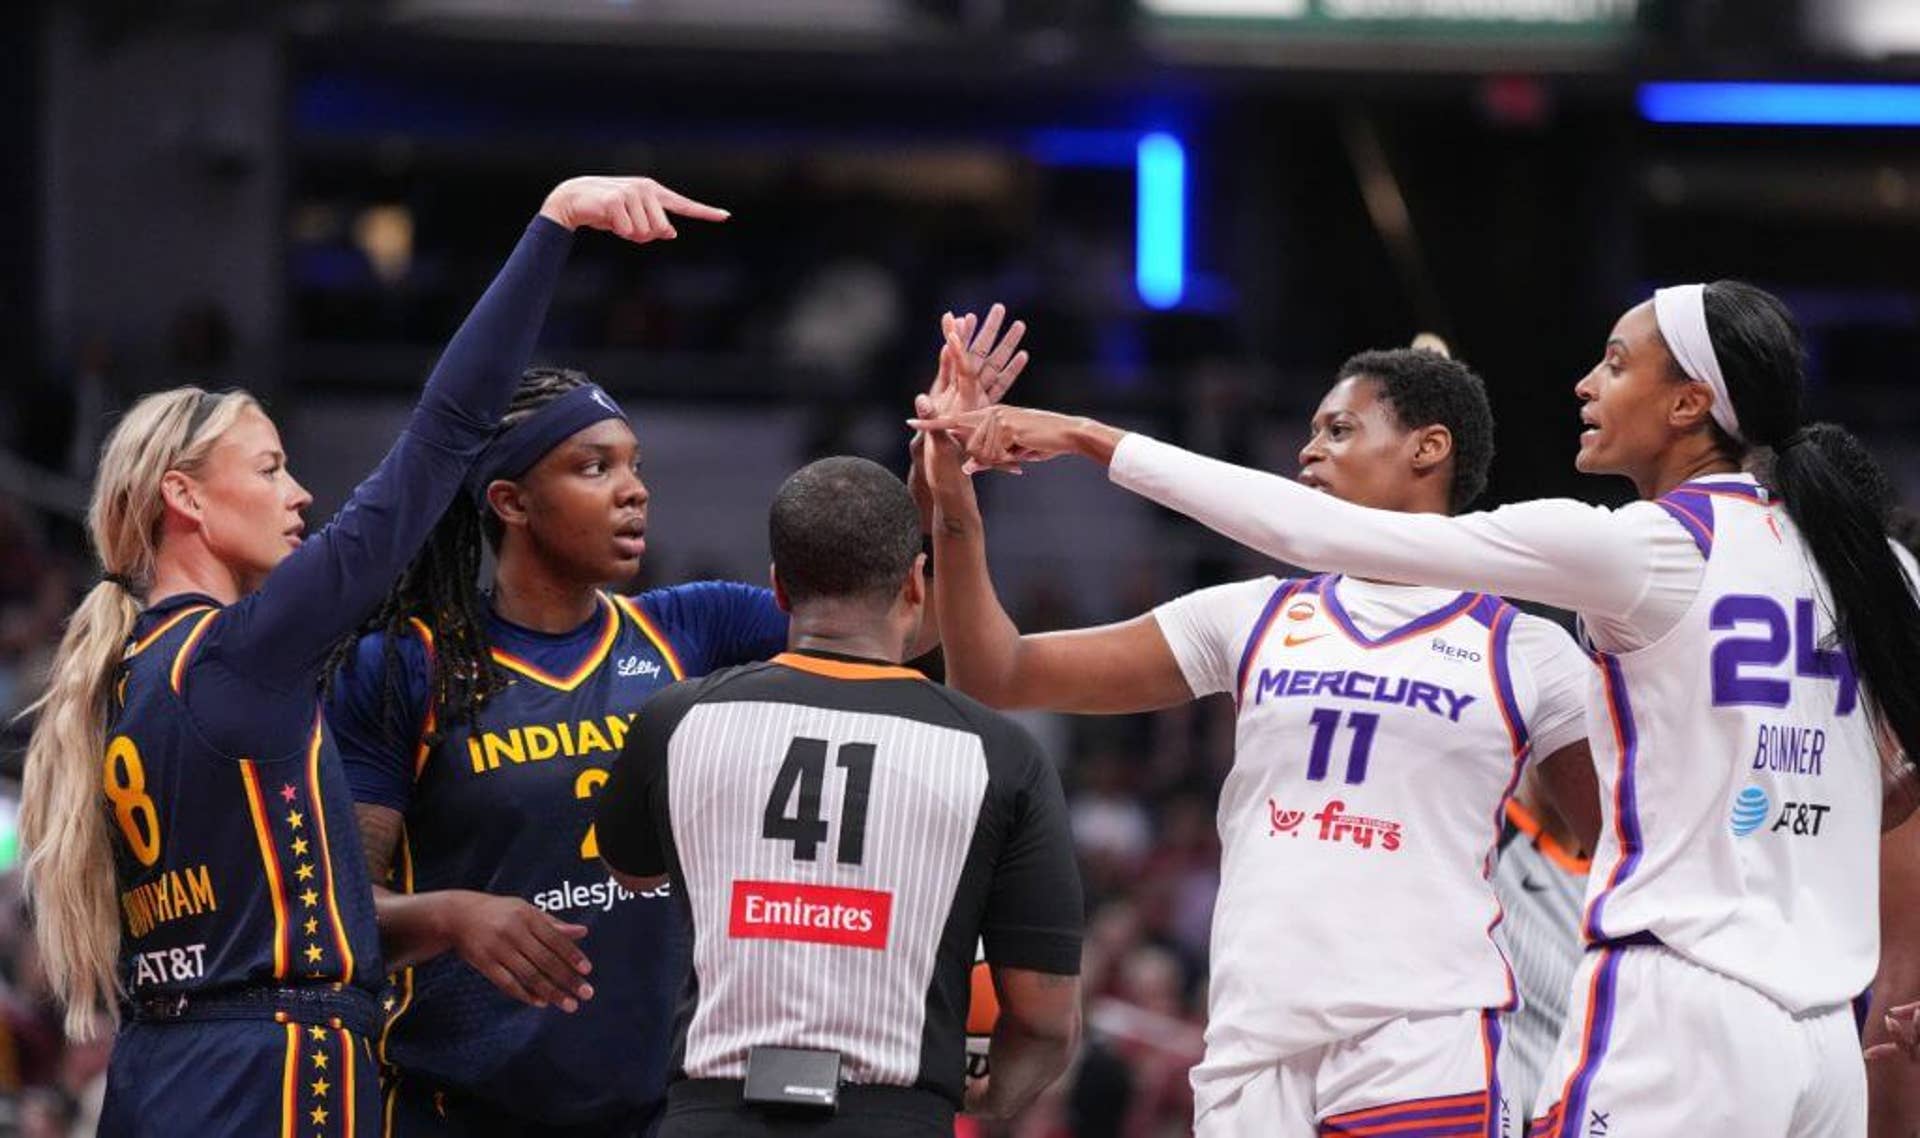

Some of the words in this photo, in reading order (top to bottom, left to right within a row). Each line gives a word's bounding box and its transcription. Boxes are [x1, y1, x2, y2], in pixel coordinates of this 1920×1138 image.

[617, 656, 662, 679] Lilly
[1709, 593, 1859, 717] 24
[1255, 668, 1477, 722] MERCURY
[467, 713, 638, 774] INDIAN
[1306, 707, 1380, 785] 11
[1753, 724, 1826, 776] BONNER
[104, 735, 162, 866] 8
[762, 736, 878, 866] 41
[1313, 801, 1401, 851] fry's
[1772, 803, 1830, 836] AT&T
[533, 874, 671, 913] salesfoe
[744, 893, 874, 932] Emirates
[137, 943, 207, 987] AT&T
